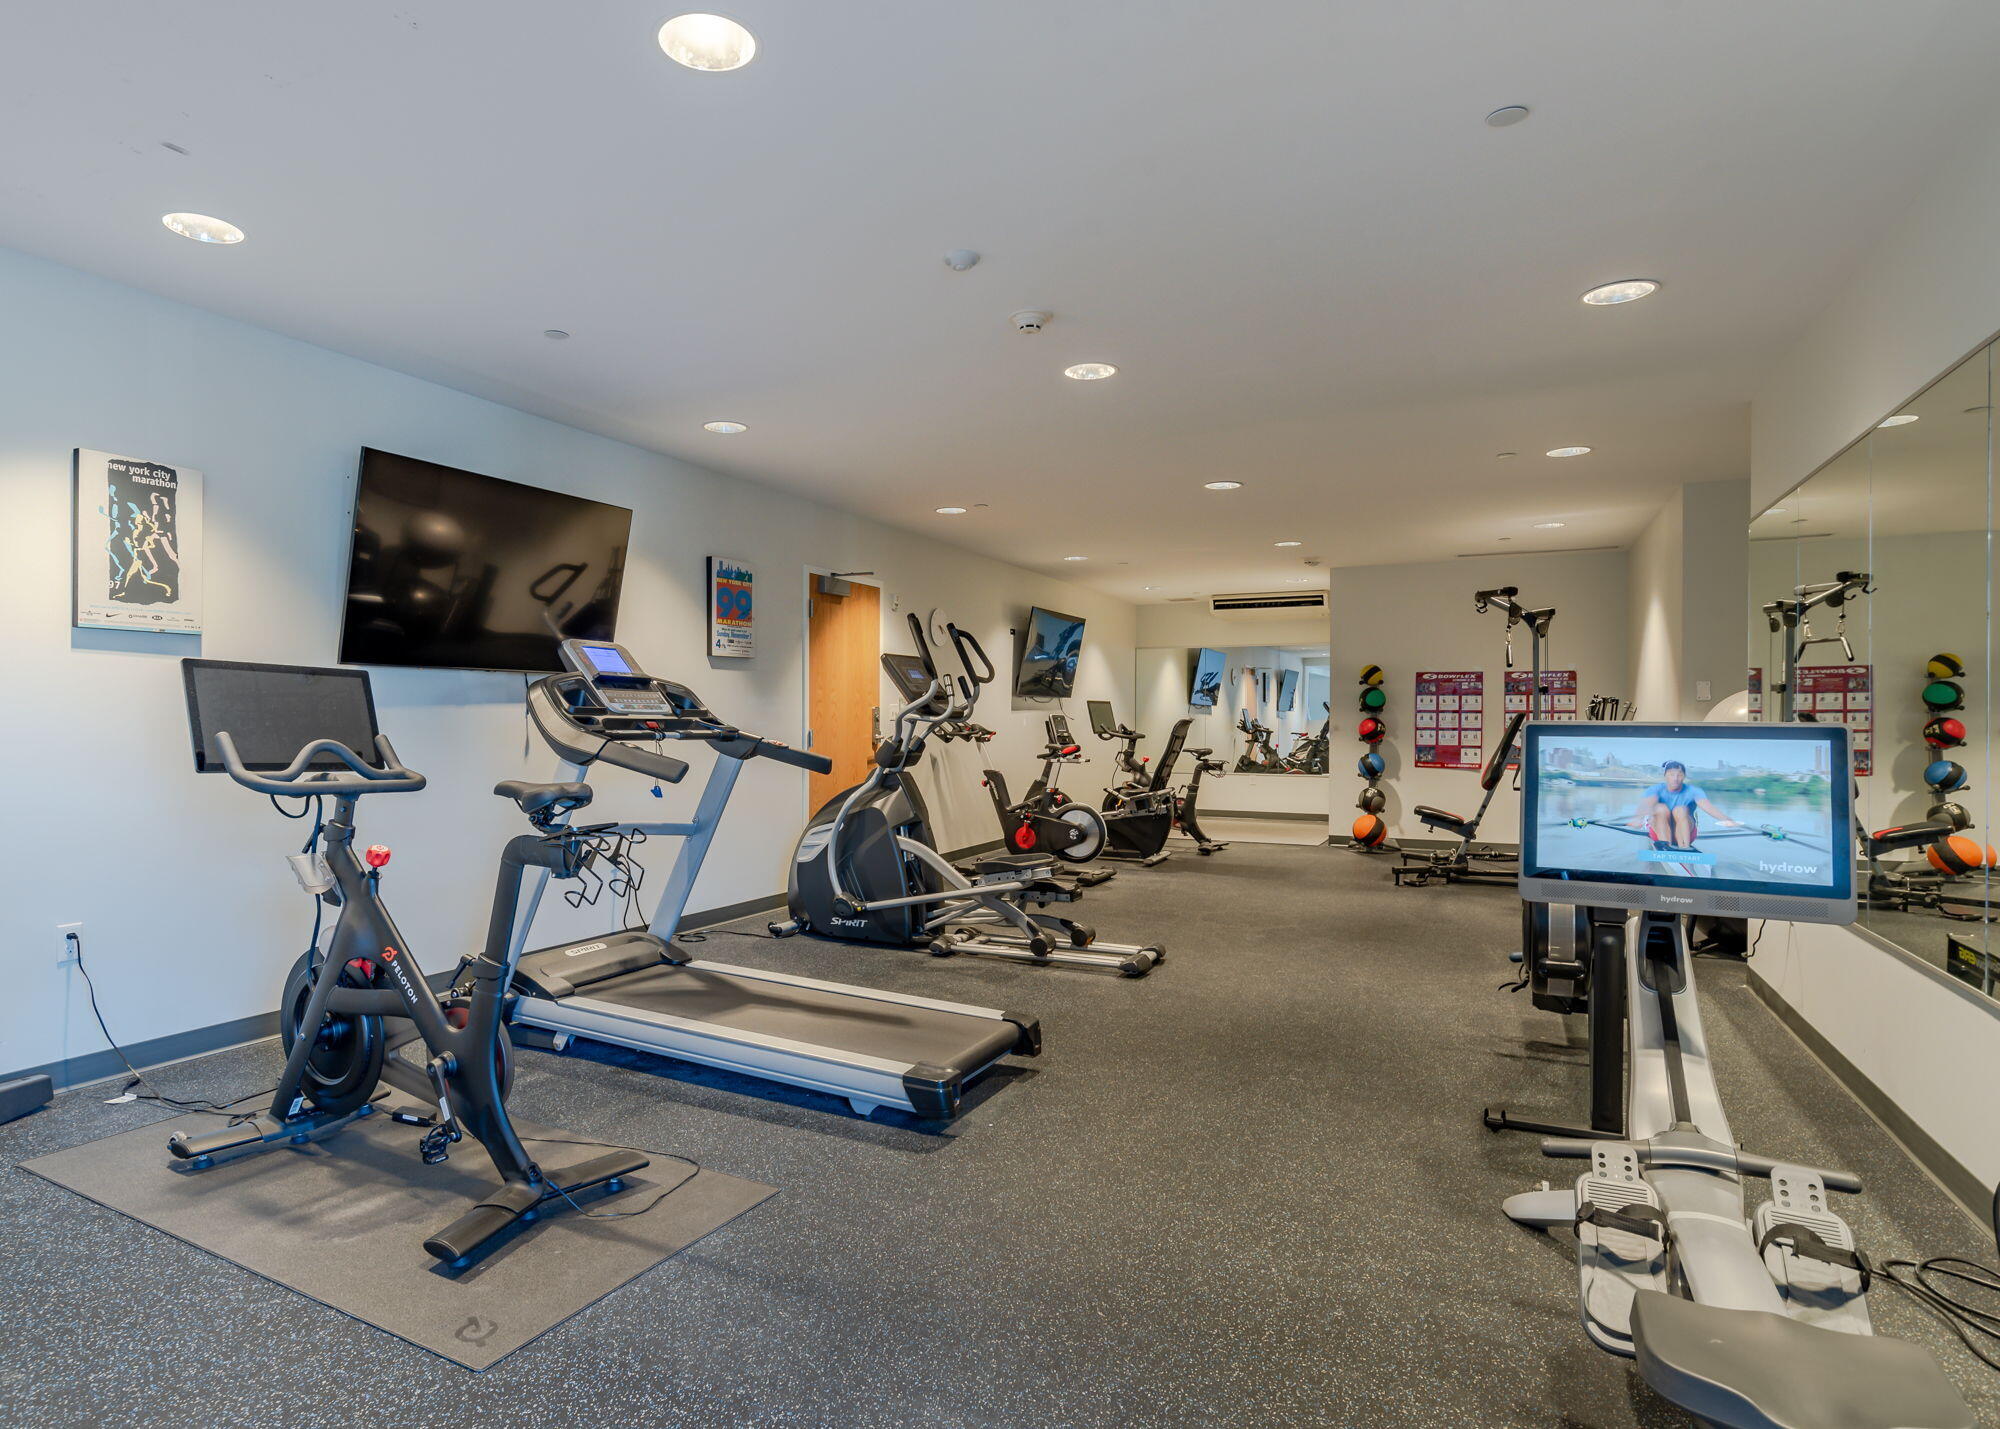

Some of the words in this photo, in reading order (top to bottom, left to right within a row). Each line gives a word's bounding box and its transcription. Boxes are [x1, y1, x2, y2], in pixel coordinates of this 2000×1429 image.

[107, 462, 126, 471] new
[129, 466, 150, 477] york
[153, 470, 171, 481] city
[132, 475, 177, 489] marathon
[108, 580, 120, 590] 97
[717, 587, 752, 619] 99
[1759, 860, 1818, 875] hydrow
[1660, 894, 1693, 904] hydrow
[830, 917, 868, 928] SPIRIT
[391, 960, 418, 1004] PELOTON
